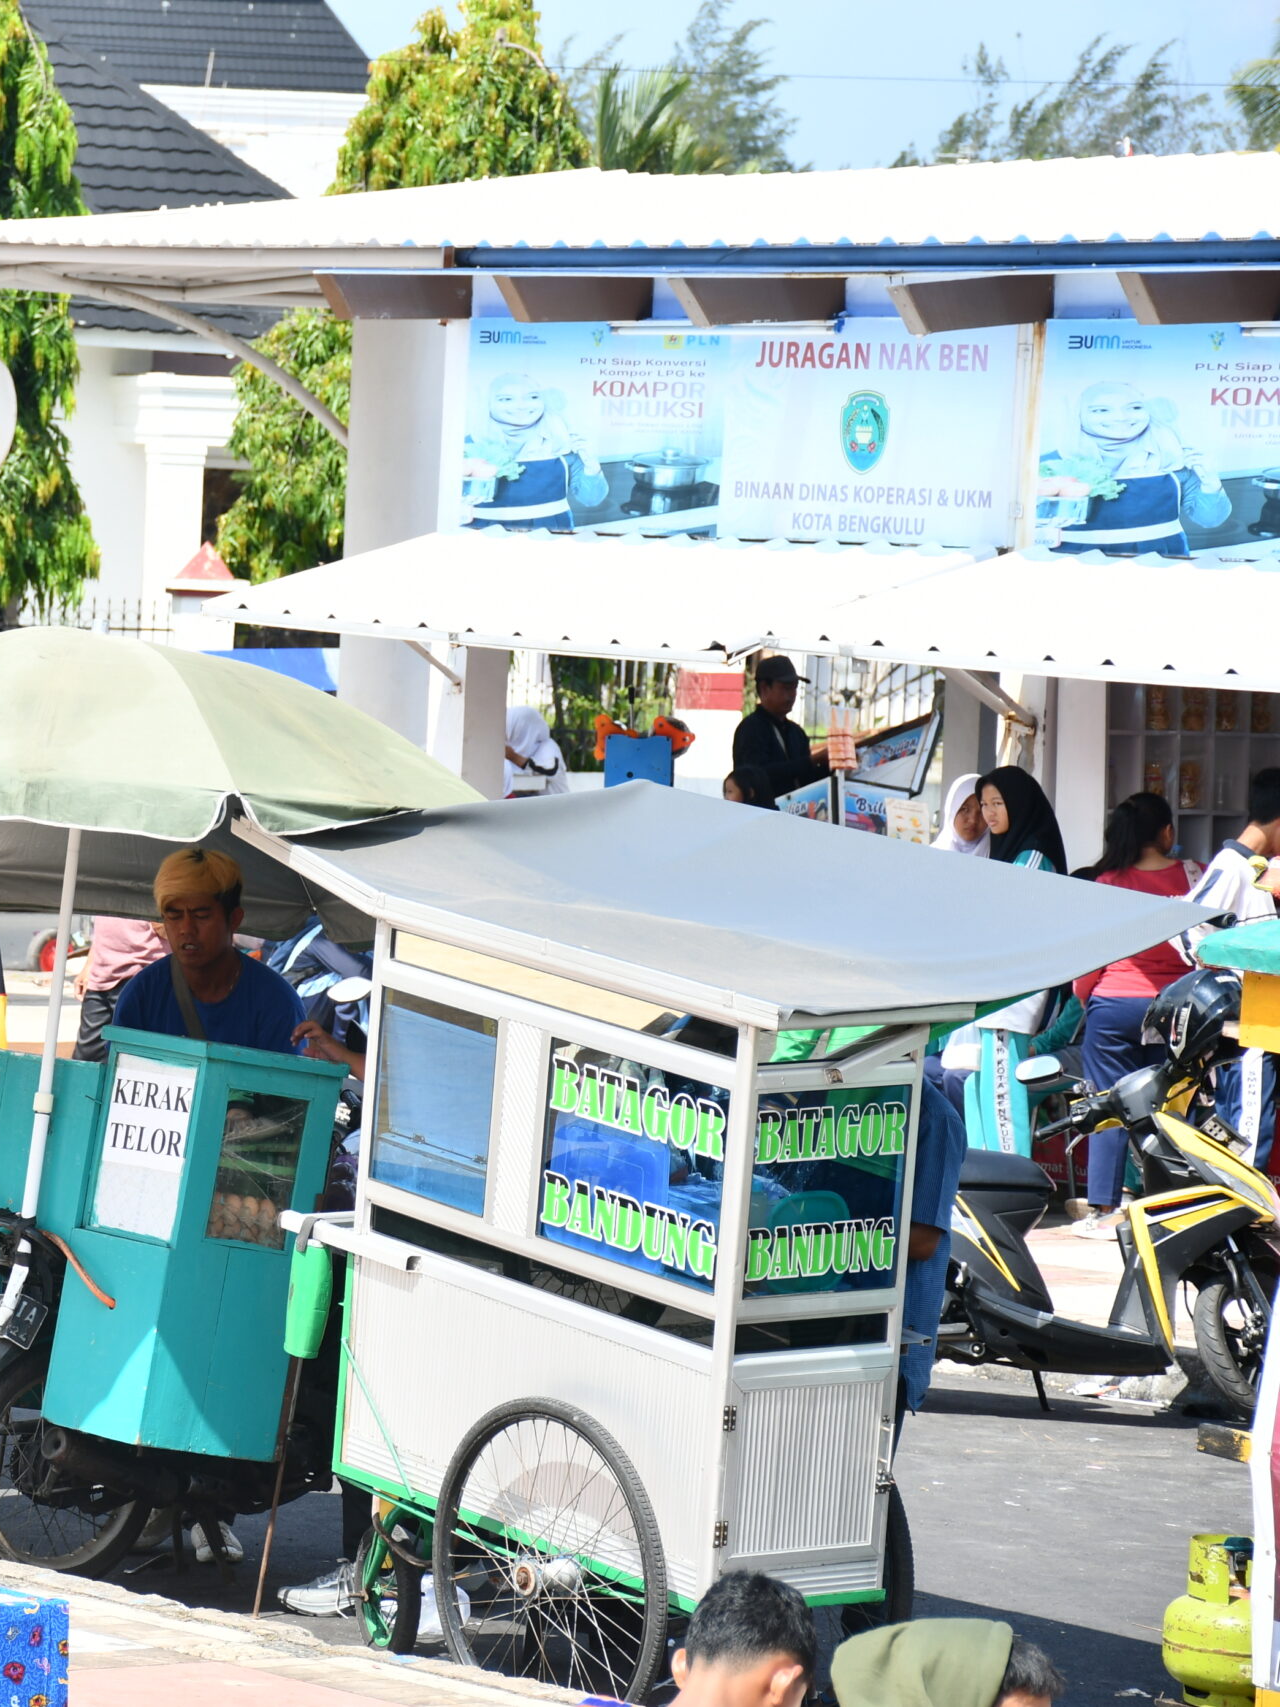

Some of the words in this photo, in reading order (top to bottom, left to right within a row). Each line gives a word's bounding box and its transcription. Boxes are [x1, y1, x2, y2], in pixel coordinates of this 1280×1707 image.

[686, 335, 720, 346] PLN
[580, 357, 607, 365] PLN
[611, 358, 641, 367] Siap
[646, 358, 706, 367] Konversi
[756, 341, 870, 369] JURAGAN
[879, 343, 930, 371] NAK
[938, 344, 989, 372] BEN
[1195, 362, 1229, 371] PLN
[1235, 362, 1272, 372] Siap
[600, 369, 651, 378] Kompor
[657, 369, 685, 377] LPG
[592, 380, 705, 399] KOMPOR
[601, 401, 703, 419] INDUKSI
[734, 481, 794, 500] BINAAN
[799, 484, 849, 503] DINAS
[853, 486, 932, 506] KOPERASI
[938, 490, 949, 506] &
[954, 489, 993, 508] UKM
[792, 512, 832, 531] KOTA
[838, 514, 926, 535] BENGKULU
[113, 1077, 192, 1113] KERAK
[550, 1053, 727, 1161] BATAGOR
[109, 1121, 182, 1157] TELOR
[755, 1101, 907, 1164] BATAGOR
[540, 1169, 718, 1281] BANDUNG
[744, 1217, 895, 1282] BANDUNG
